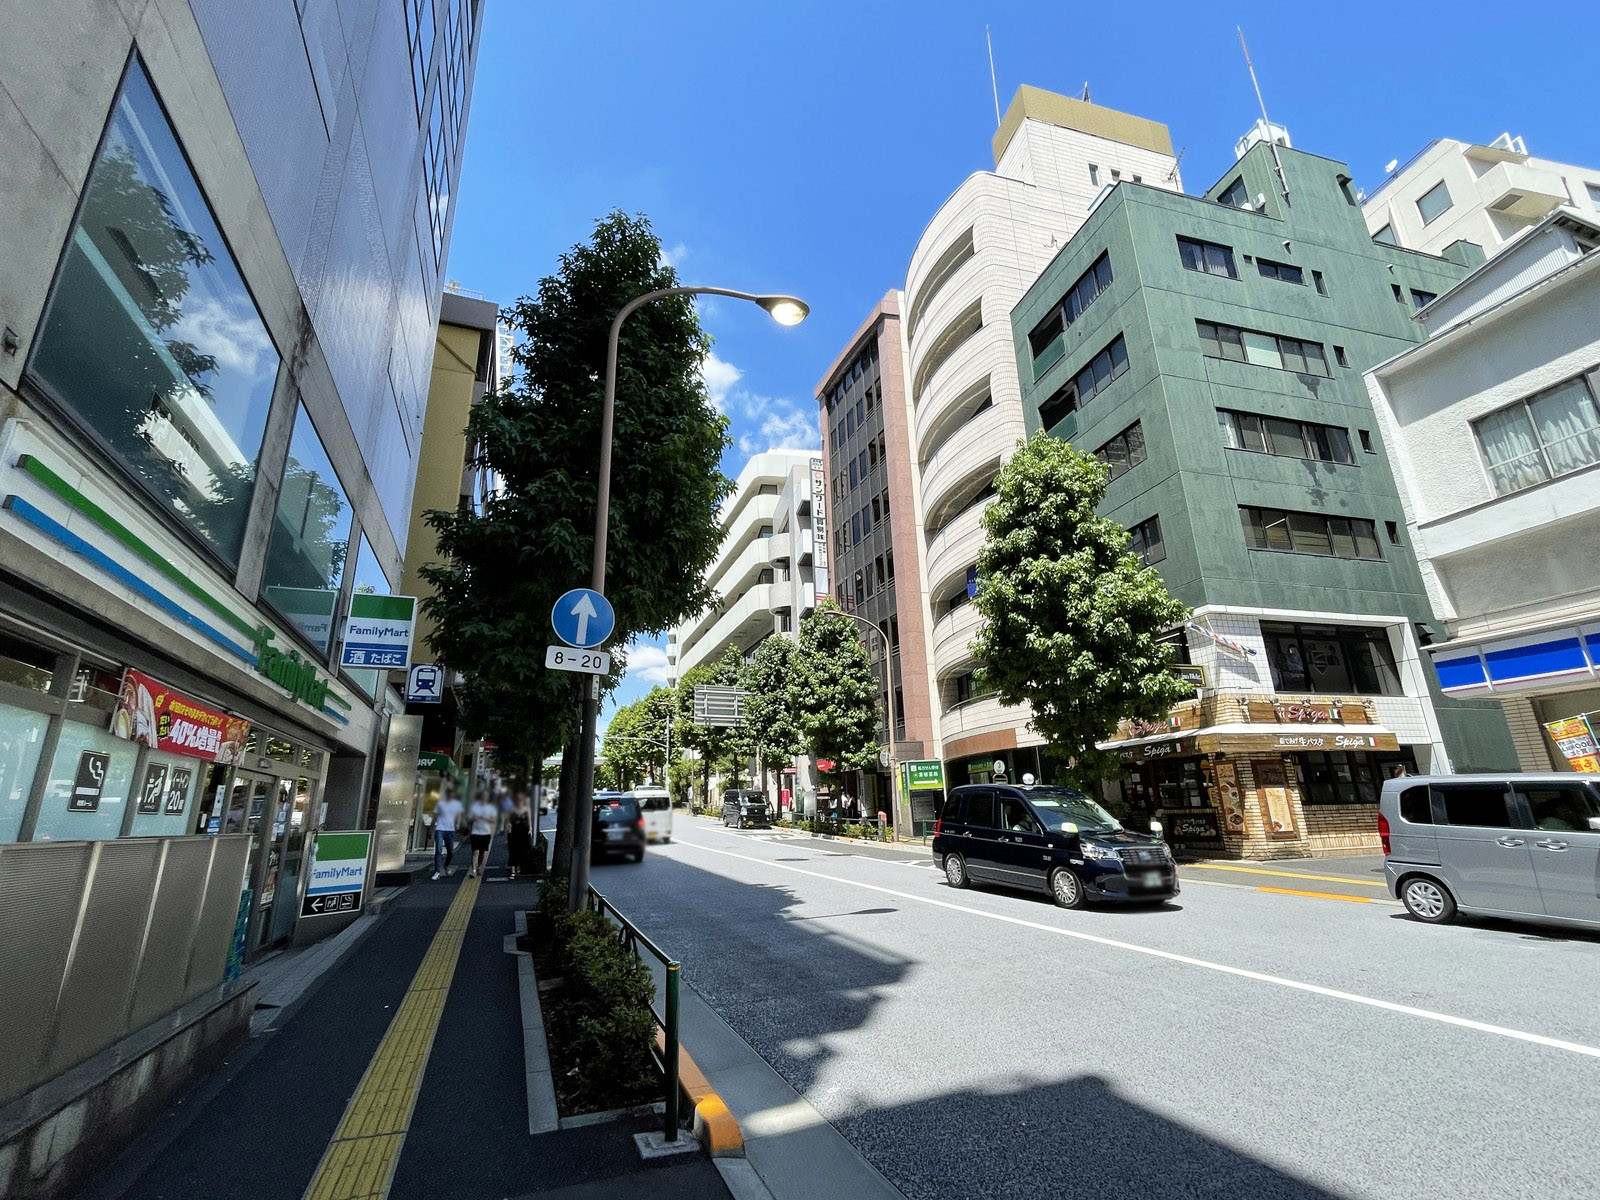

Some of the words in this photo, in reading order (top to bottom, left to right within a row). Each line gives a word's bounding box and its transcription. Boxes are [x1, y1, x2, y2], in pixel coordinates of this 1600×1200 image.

[349, 625, 409, 638] FamilyMart
[349, 650, 366, 664] 酒
[370, 653, 402, 664] たばこ
[1288, 704, 1328, 722] Spiga
[1335, 735, 1366, 749] Spiga
[1144, 744, 1172, 758] Spiga
